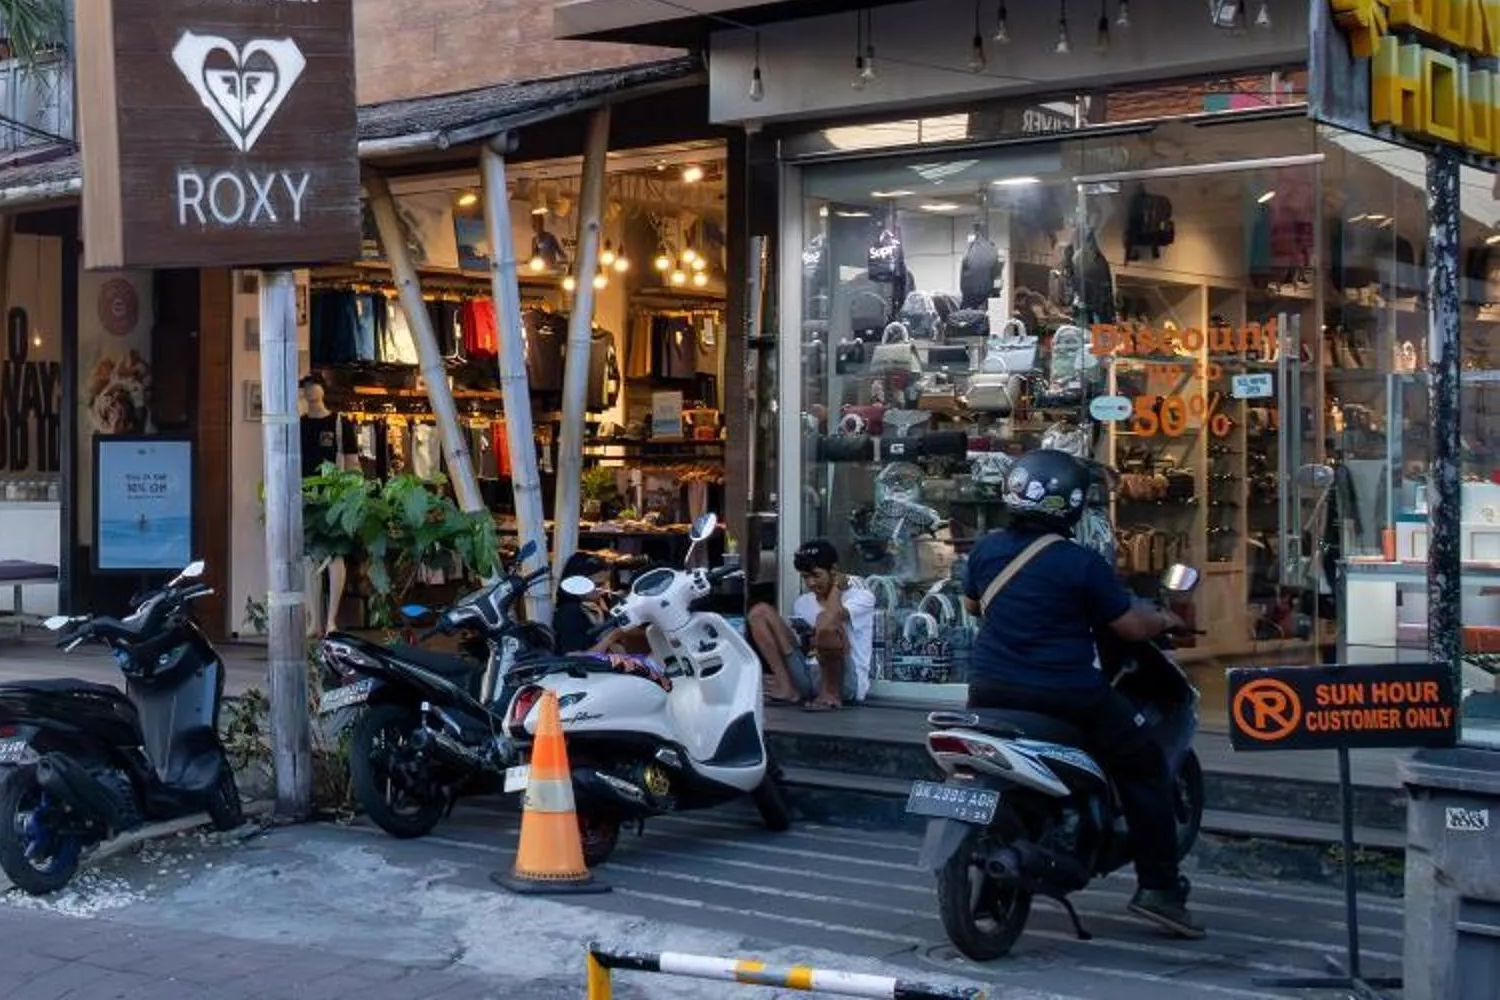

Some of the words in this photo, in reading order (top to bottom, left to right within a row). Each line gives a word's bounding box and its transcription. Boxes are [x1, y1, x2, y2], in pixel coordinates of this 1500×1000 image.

[176, 171, 311, 225] ROXY
[1090, 316, 1280, 356] Discount
[1132, 391, 1231, 437] 50%
[1315, 683, 1365, 706] SUN
[1372, 681, 1440, 704] HOUR
[1305, 708, 1402, 732] CUSTOMER
[1405, 707, 1453, 730] ONLY
